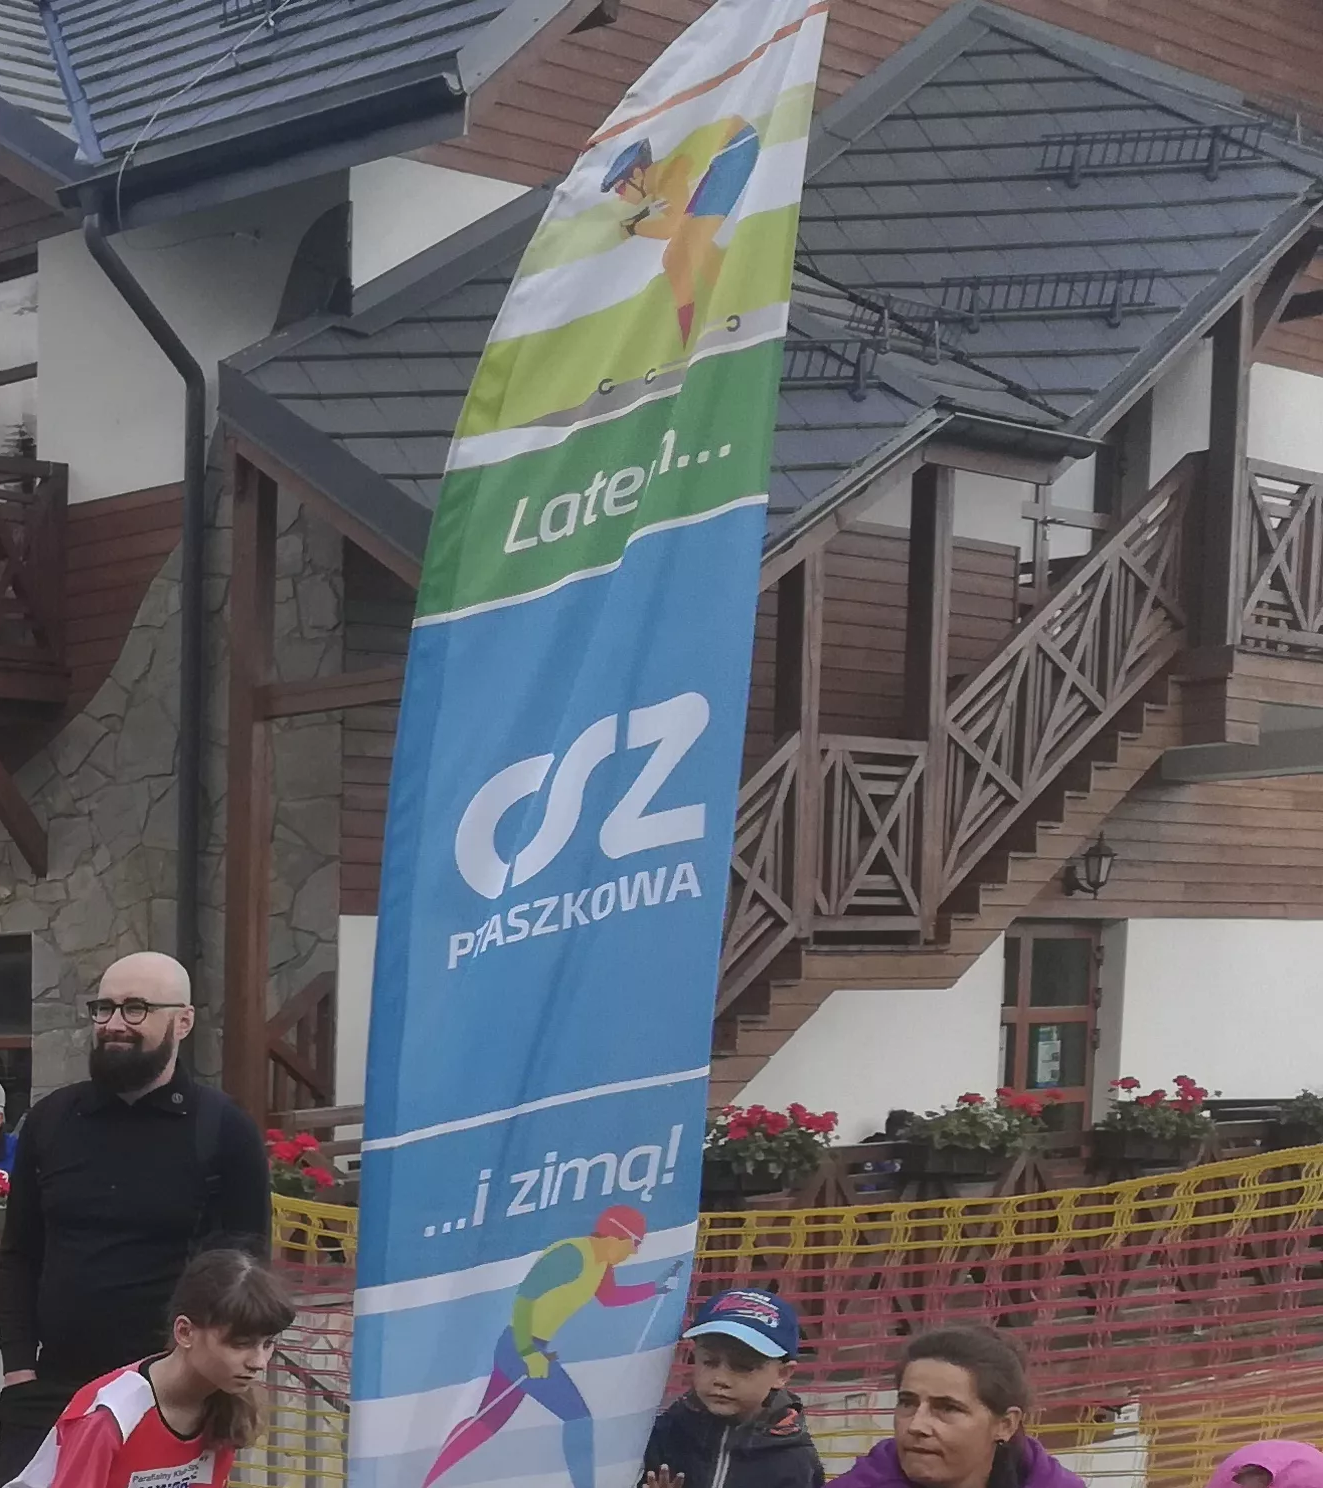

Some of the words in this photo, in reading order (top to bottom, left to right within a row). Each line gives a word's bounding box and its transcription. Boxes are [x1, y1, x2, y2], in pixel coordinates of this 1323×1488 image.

[455, 691, 710, 900] OSZ
[447, 861, 702, 970] PTASZKOWA
[506, 1124, 684, 1218] zimą!
